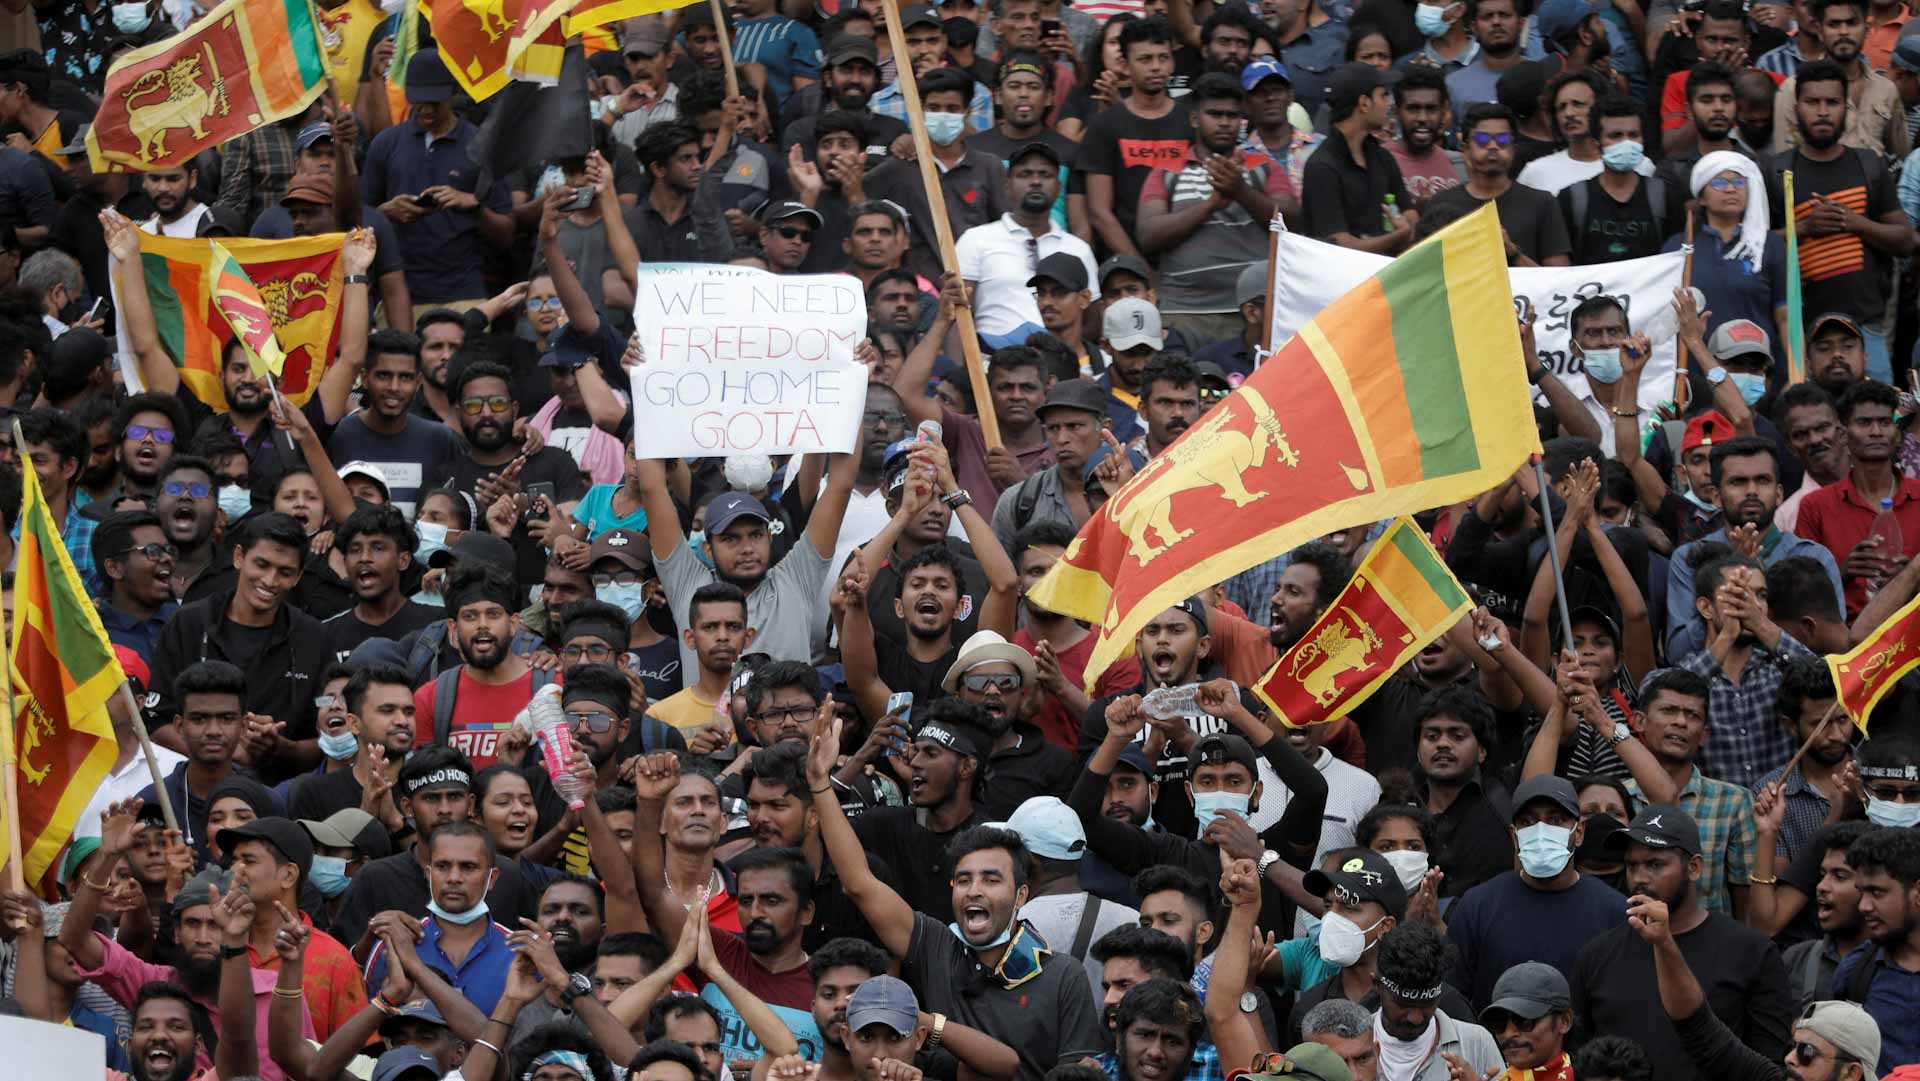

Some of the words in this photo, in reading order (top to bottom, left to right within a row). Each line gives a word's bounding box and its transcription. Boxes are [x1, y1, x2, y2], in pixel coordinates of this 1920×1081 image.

[654, 282, 726, 316] WE
[751, 283, 857, 315] NEED
[660, 326, 857, 364] FREEDOM
[644, 370, 711, 407] GO
[720, 369, 841, 405] HOME
[691, 408, 825, 451] GOTA
[429, 769, 445, 783] GO
[1401, 988, 1419, 1000] GO
